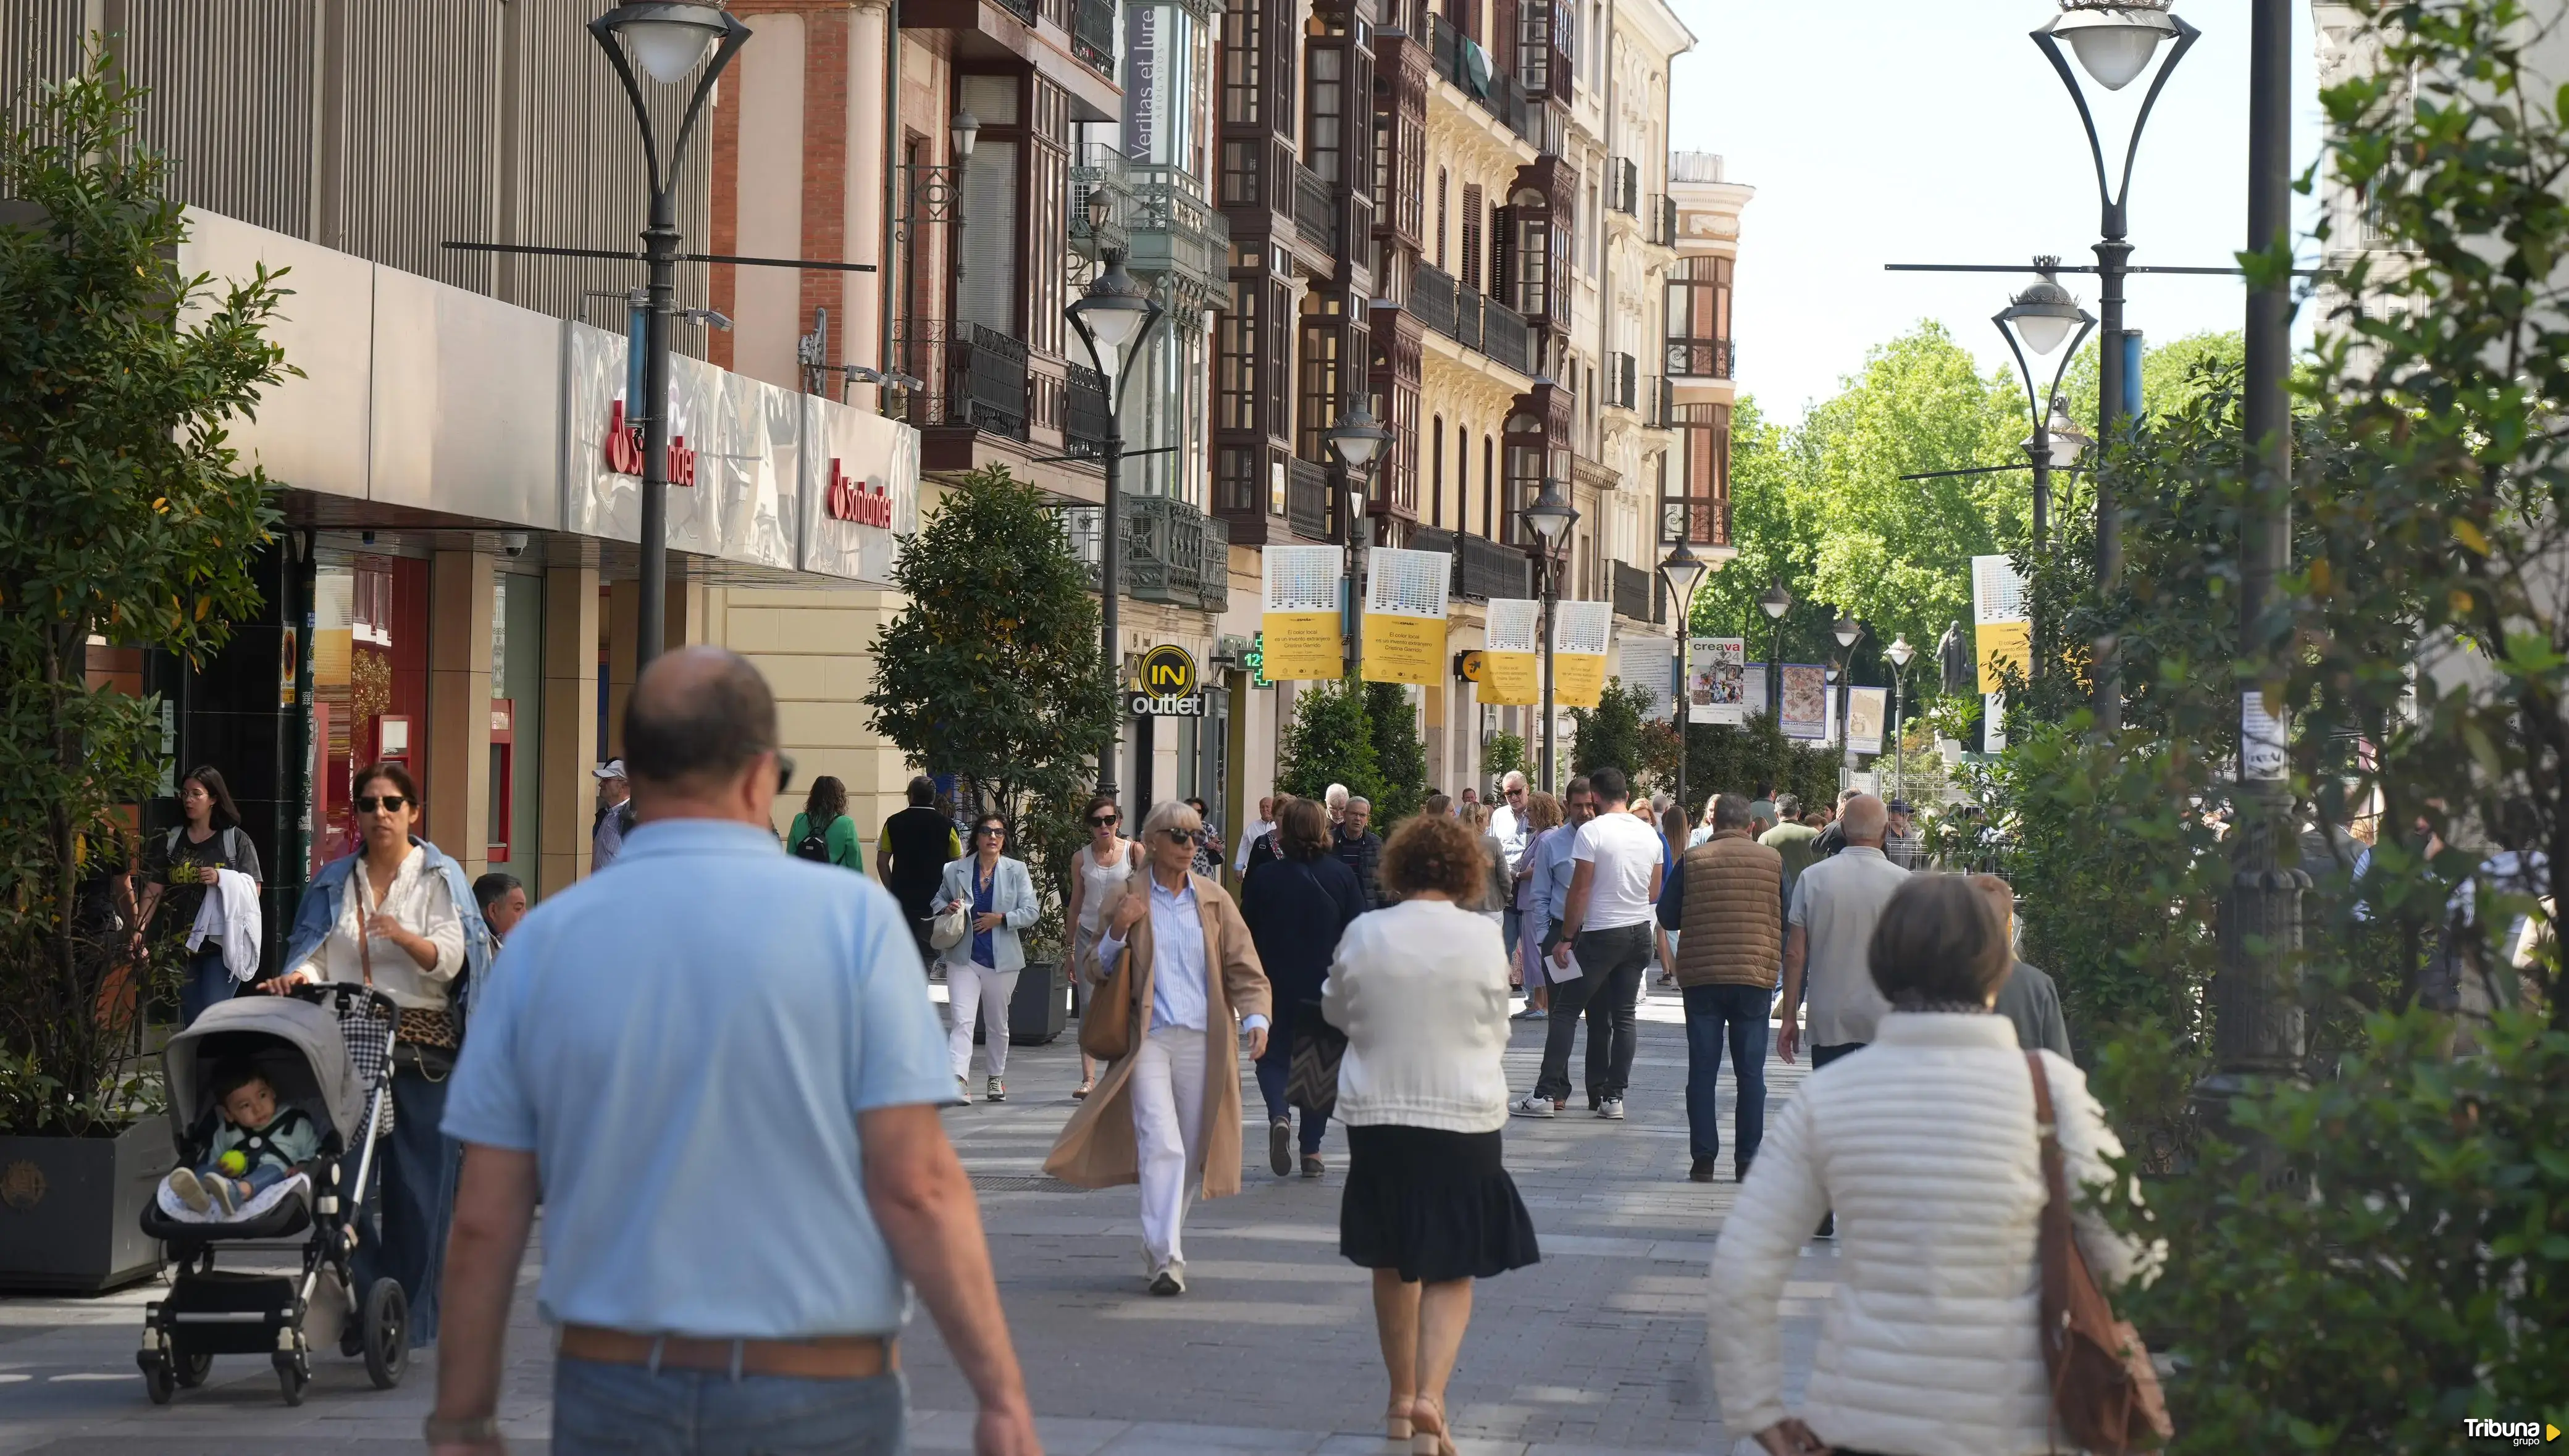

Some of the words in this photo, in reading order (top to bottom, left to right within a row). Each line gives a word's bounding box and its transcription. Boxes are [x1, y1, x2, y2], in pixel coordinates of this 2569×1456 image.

[1137, 59, 1154, 79] et
[1131, 87, 1153, 159] Veritas
[631, 428, 699, 487] Snder
[846, 476, 895, 530] Santander
[1693, 643, 1740, 651] creava
[1724, 651, 1740, 662] 24
[1152, 665, 1186, 685] IN
[1132, 693, 1201, 715] outlet
